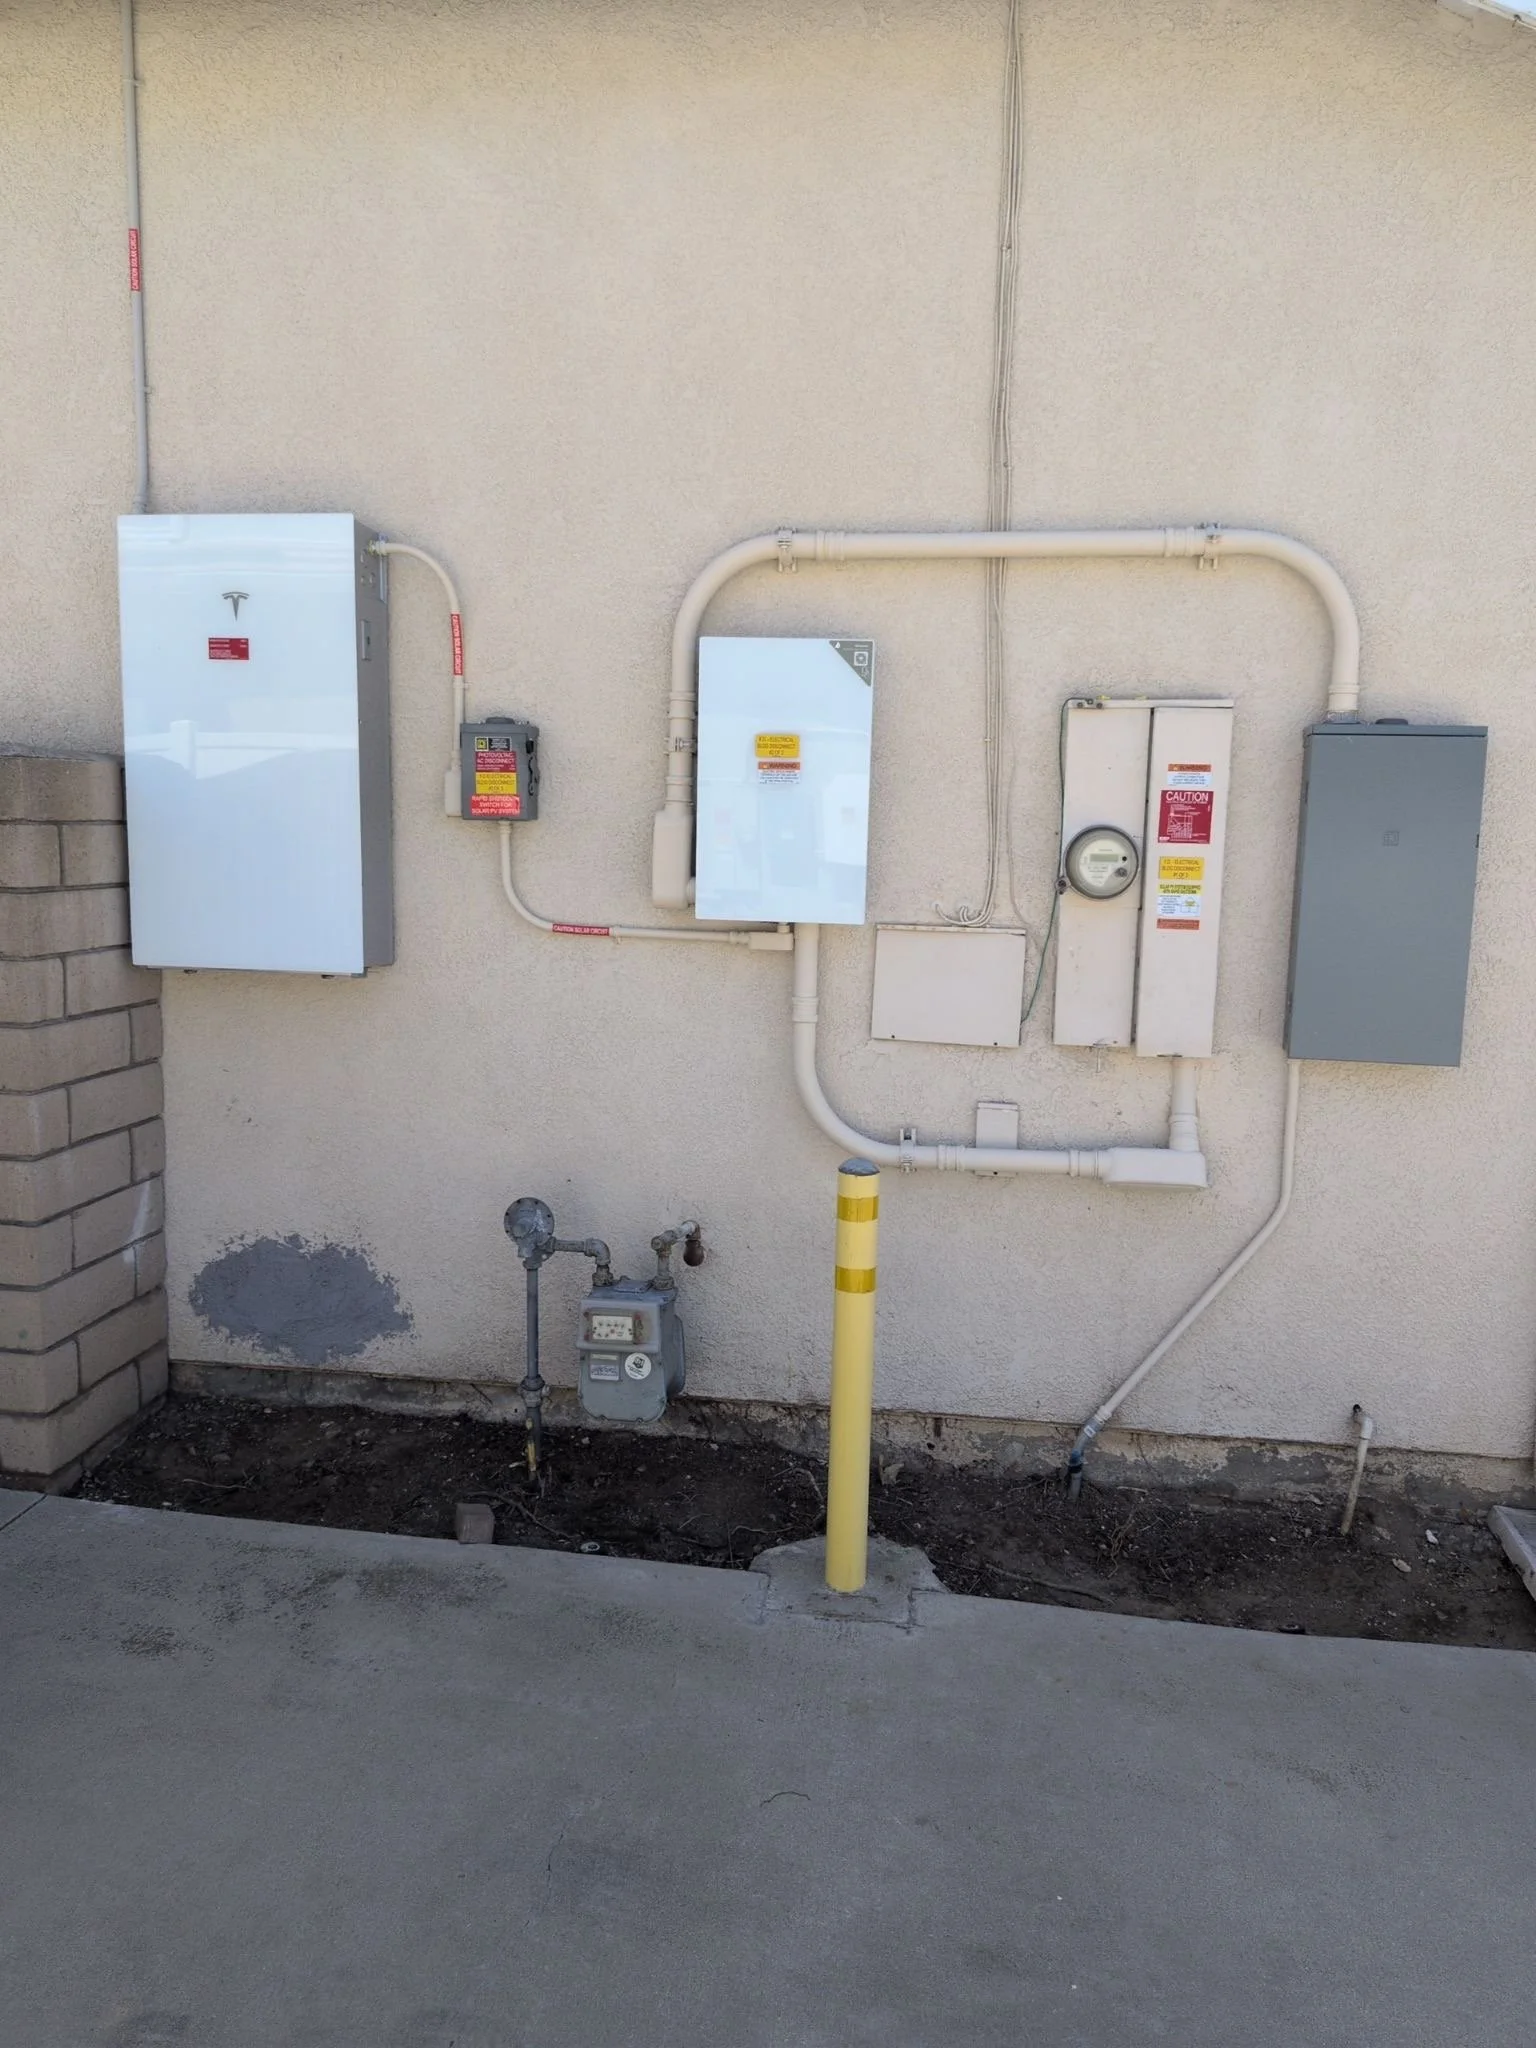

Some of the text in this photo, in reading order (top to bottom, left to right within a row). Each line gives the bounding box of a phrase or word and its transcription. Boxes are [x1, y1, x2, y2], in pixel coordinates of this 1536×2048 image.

[129, 230, 137, 250] CIRCUIT
[131, 268, 139, 289] CAUTION
[452, 615, 460, 637] CAUTION
[1166, 791, 1209, 802] CAUTION
